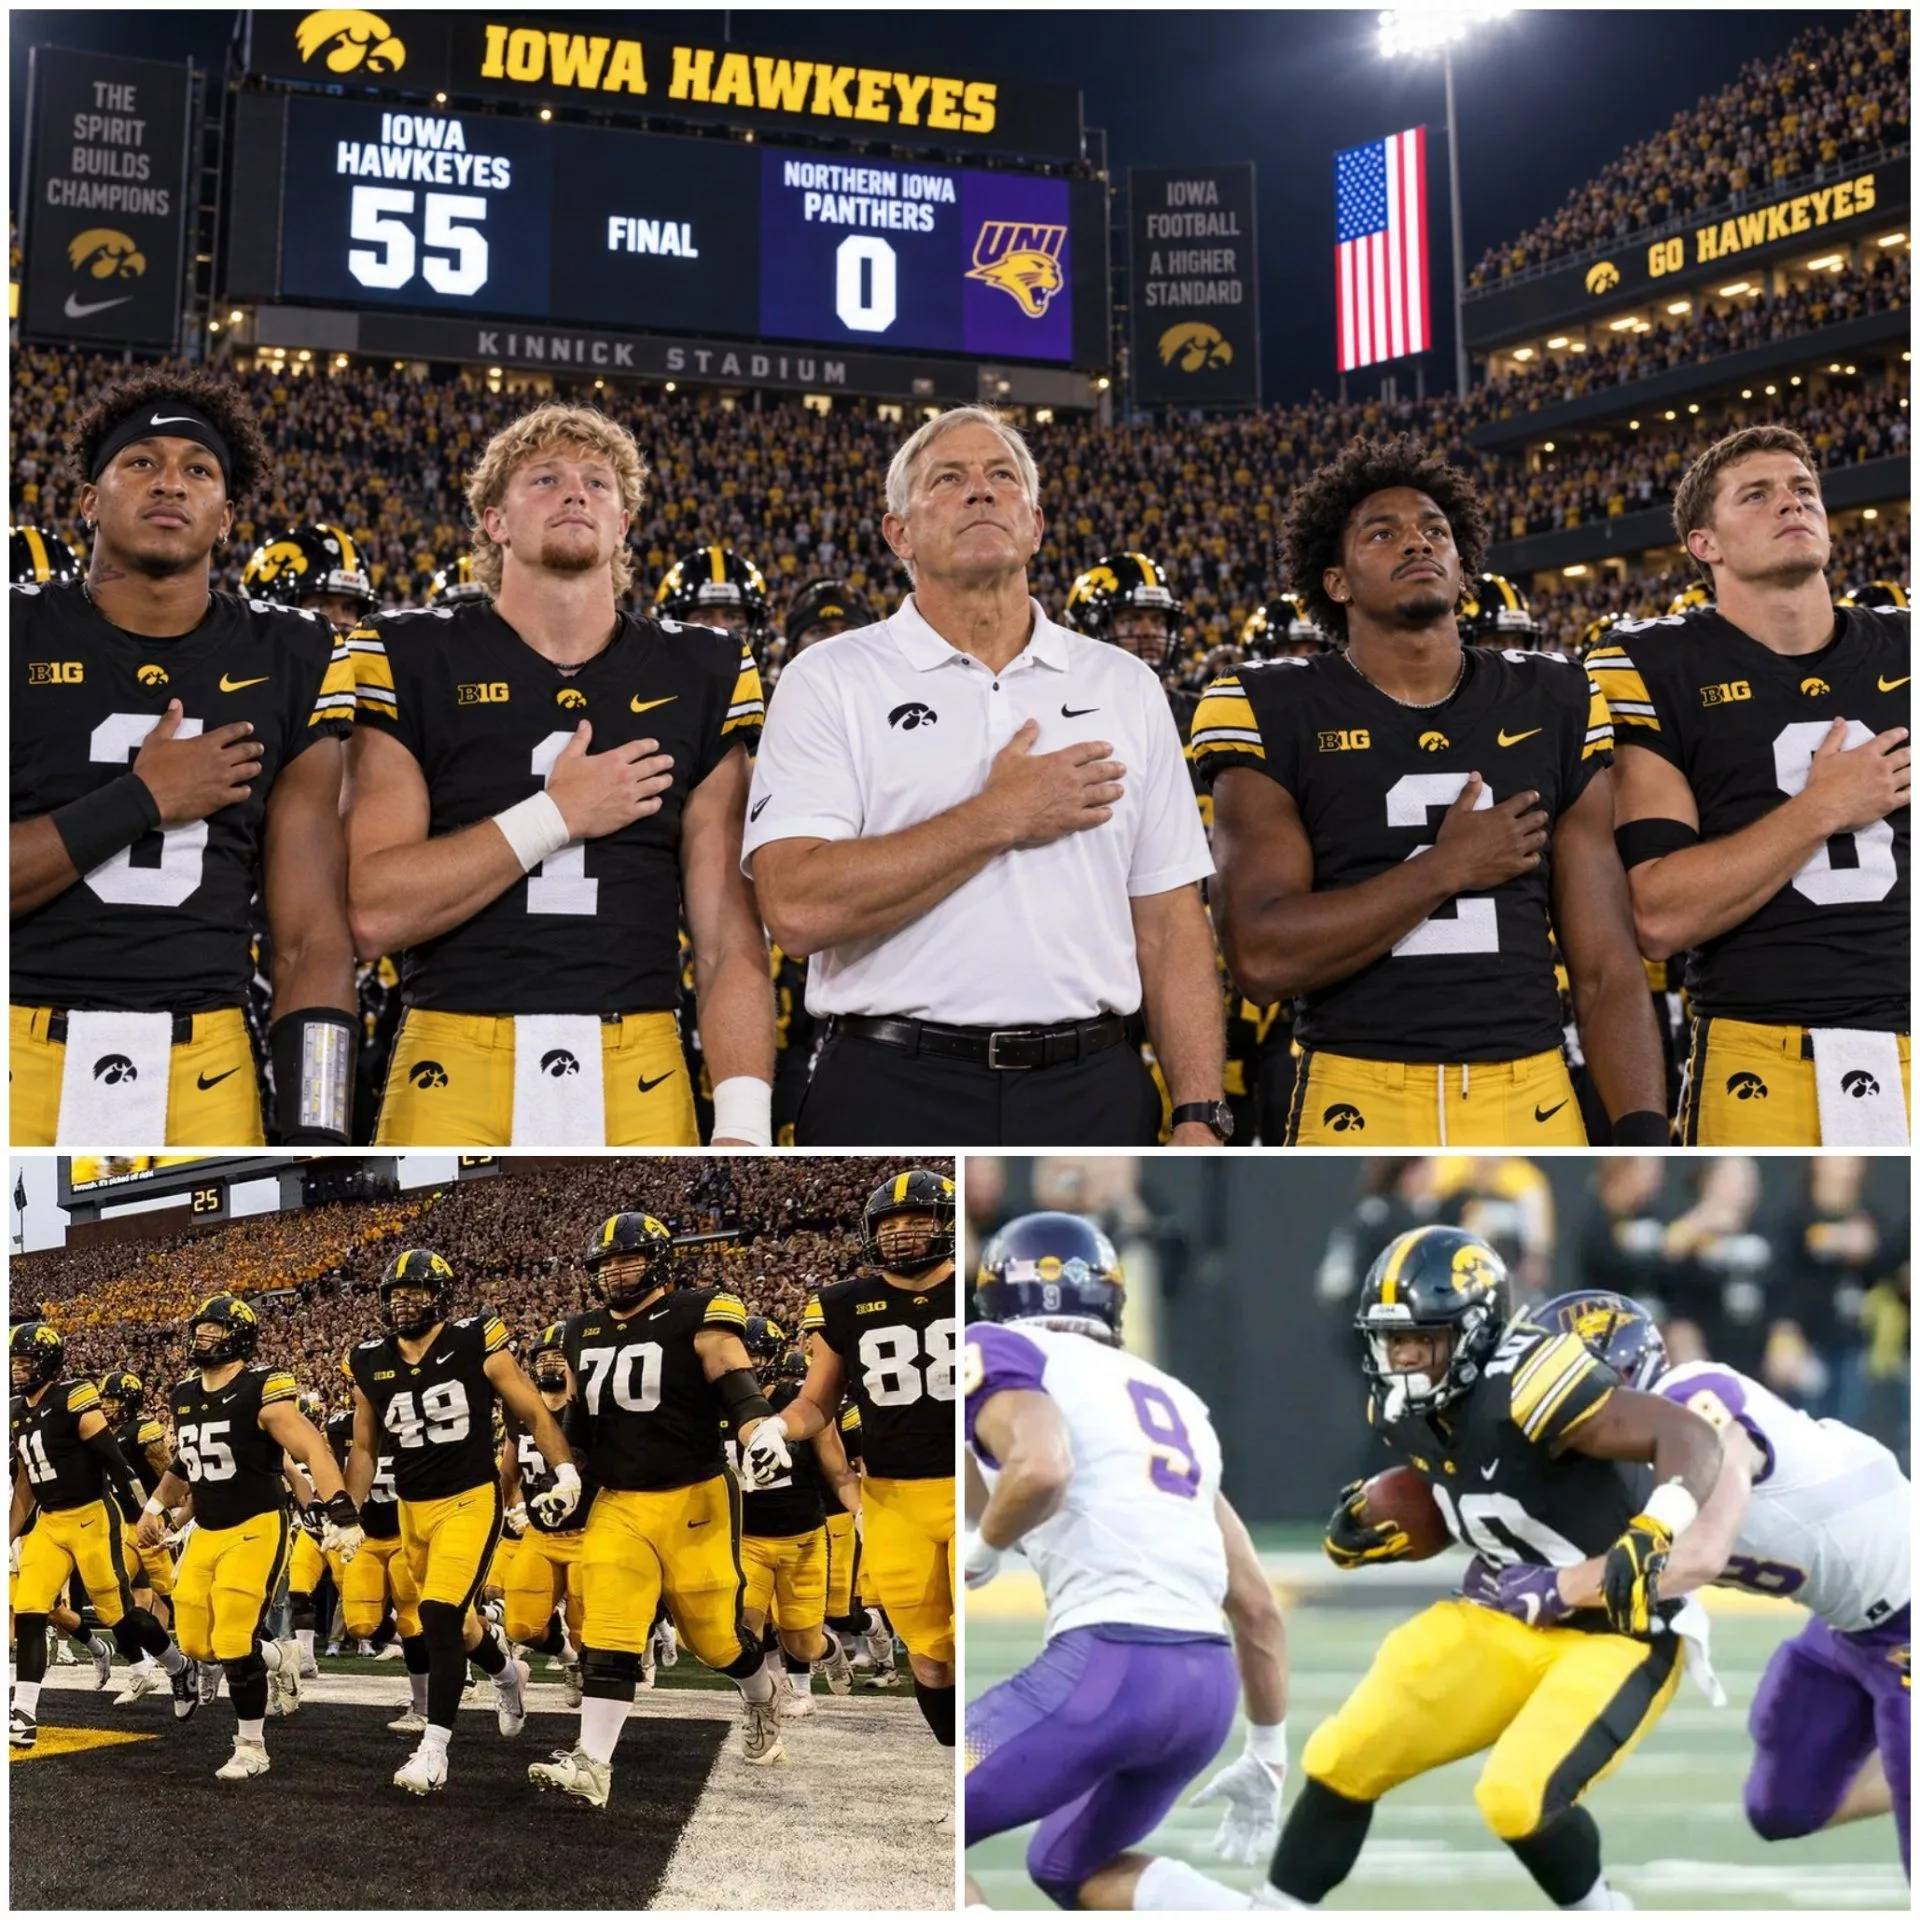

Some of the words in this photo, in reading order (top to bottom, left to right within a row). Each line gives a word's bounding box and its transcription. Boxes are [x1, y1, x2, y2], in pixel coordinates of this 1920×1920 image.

[93, 81, 136, 112] THE
[481, 24, 648, 95] IOWA
[668, 46, 997, 134] HAWKEYES
[73, 114, 146, 147] SPIRIT
[381, 113, 466, 153] IOWA
[72, 148, 150, 181] BUILDS
[336, 141, 511, 190] HAWKEYES
[783, 160, 898, 199] NORTHERN
[902, 174, 956, 203] IOWA
[47, 178, 170, 216] CHAMPIONS
[804, 192, 935, 232] PANTHERS
[1166, 181, 1219, 207] IOWA
[348, 185, 489, 297] 55
[608, 216, 699, 258] FINAL
[973, 220, 1068, 268] UNI
[1146, 212, 1241, 239] FOOTBALL
[1648, 236, 1684, 278] GO
[1697, 173, 1876, 264] HAWKEYES
[835, 235, 897, 332] 0
[1149, 252, 1163, 276] A
[1168, 249, 1236, 275] HIGHER
[1145, 280, 1243, 307] STANDARD
[478, 332, 634, 367] KINNICK
[666, 347, 847, 385] STADIUM
[526, 730, 599, 915] 1
[1385, 772, 1500, 957] 2
[193, 1188, 218, 1213] 25
[1042, 1285, 1062, 1311] 9
[579, 1341, 663, 1416] 70
[384, 1379, 470, 1448] 49
[17, 1429, 58, 1484] 11
[178, 1420, 237, 1482] 65
[1126, 1377, 1202, 1500] 9
